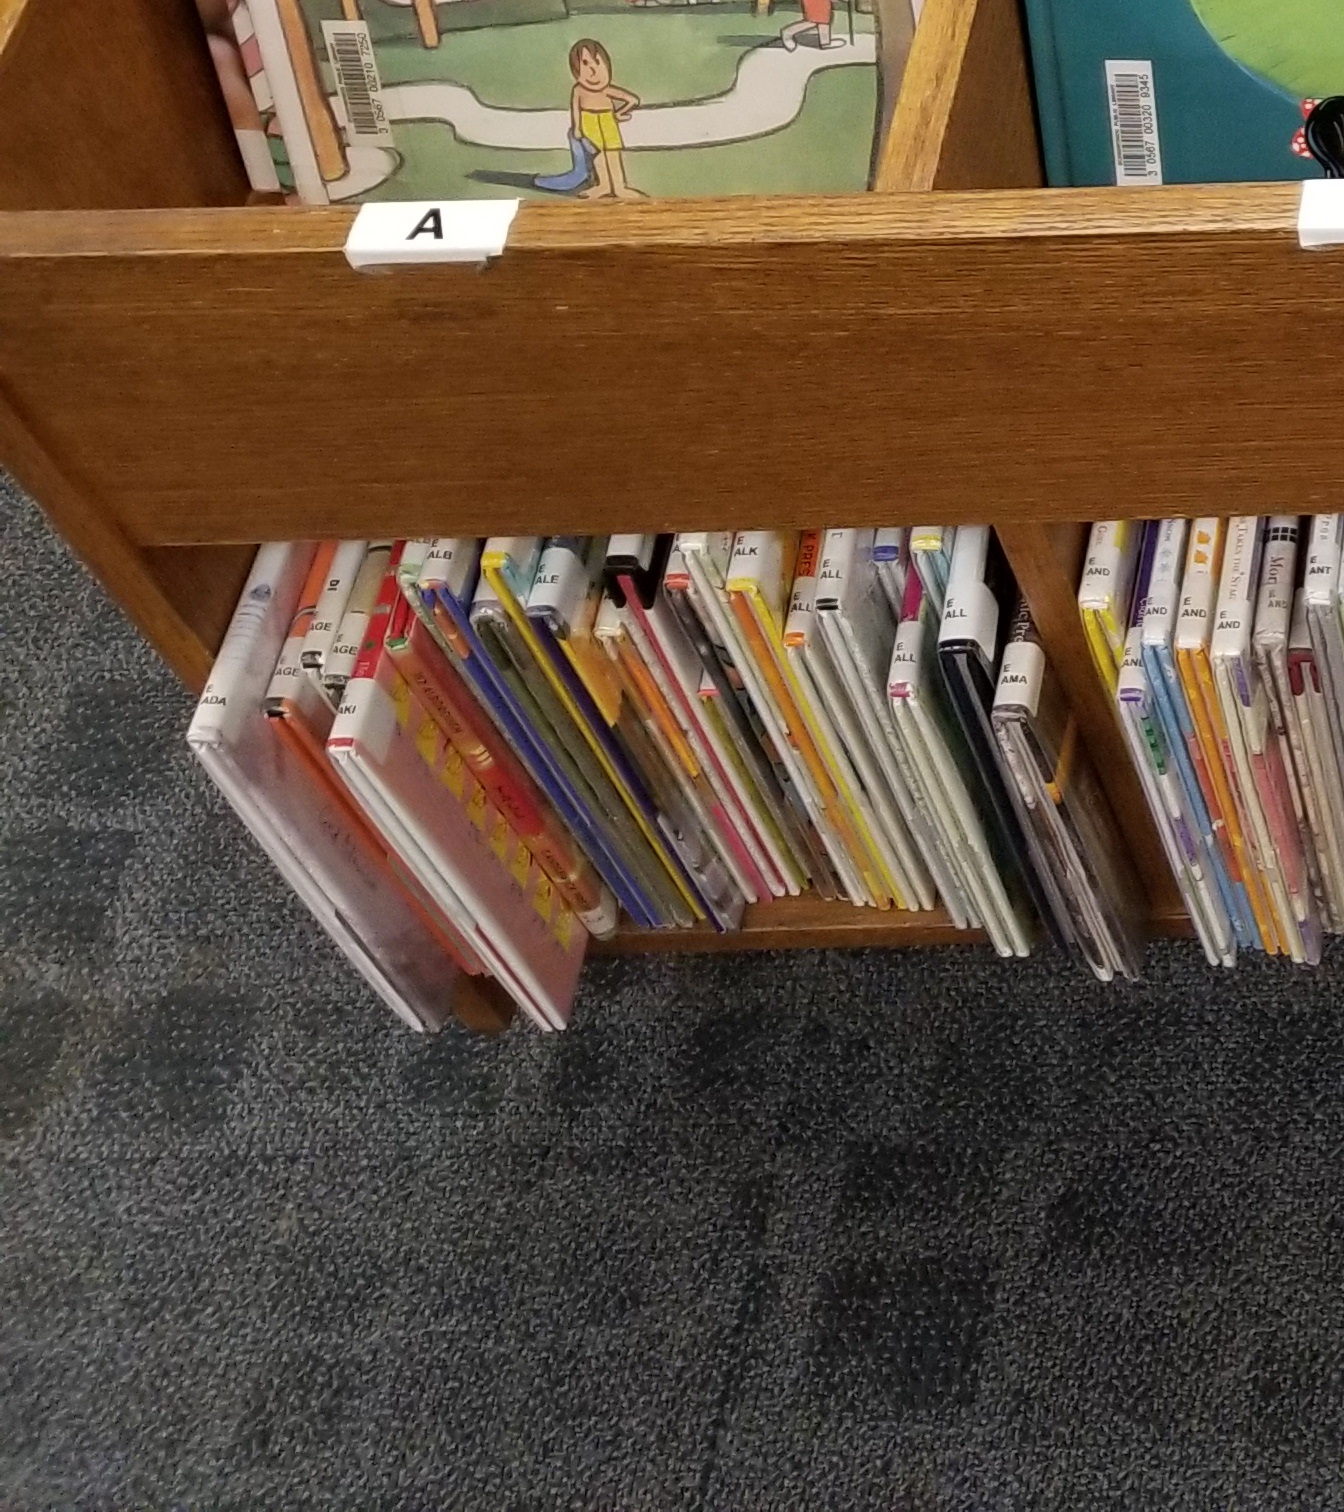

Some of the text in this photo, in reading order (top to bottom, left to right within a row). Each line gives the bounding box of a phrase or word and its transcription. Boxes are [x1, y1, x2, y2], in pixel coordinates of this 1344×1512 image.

[406, 206, 445, 241] A
[428, 549, 453, 561] ALB
[734, 546, 758, 556] ALK
[820, 569, 843, 579] ALL
[1086, 567, 1110, 577] AND
[1309, 566, 1332, 576] ANT
[535, 574, 559, 584] ALE
[944, 608, 968, 618] ALL
[1146, 606, 1168, 615] AND
[1182, 608, 1206, 618] AND
[1217, 620, 1241, 630] AND
[332, 644, 358, 656] AGE
[894, 652, 917, 663] ALL
[1001, 674, 1028, 685] AMA
[202, 695, 227, 706] ADA
